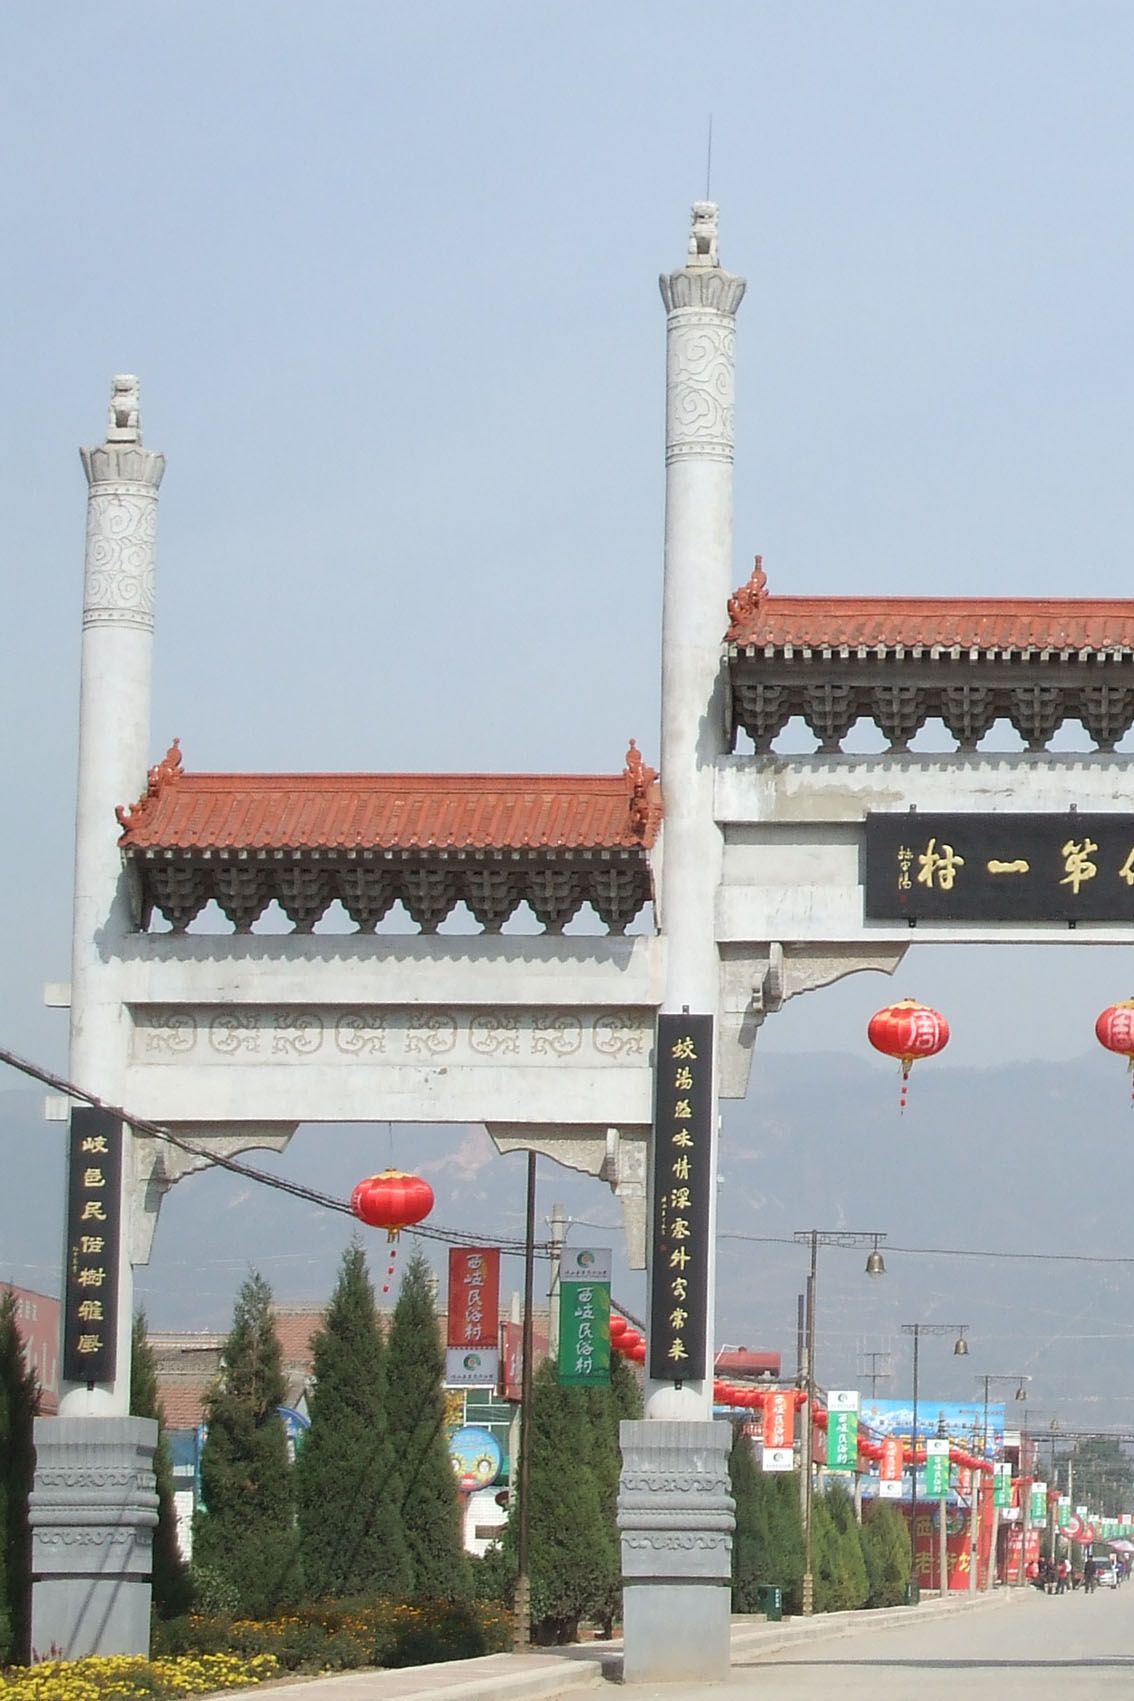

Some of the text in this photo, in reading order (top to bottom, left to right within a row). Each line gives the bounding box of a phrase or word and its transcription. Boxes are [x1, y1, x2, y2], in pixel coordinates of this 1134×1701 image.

[463, 1254, 485, 1341] 西岐民俗村
[574, 1287, 595, 1374] 西岐民俗村
